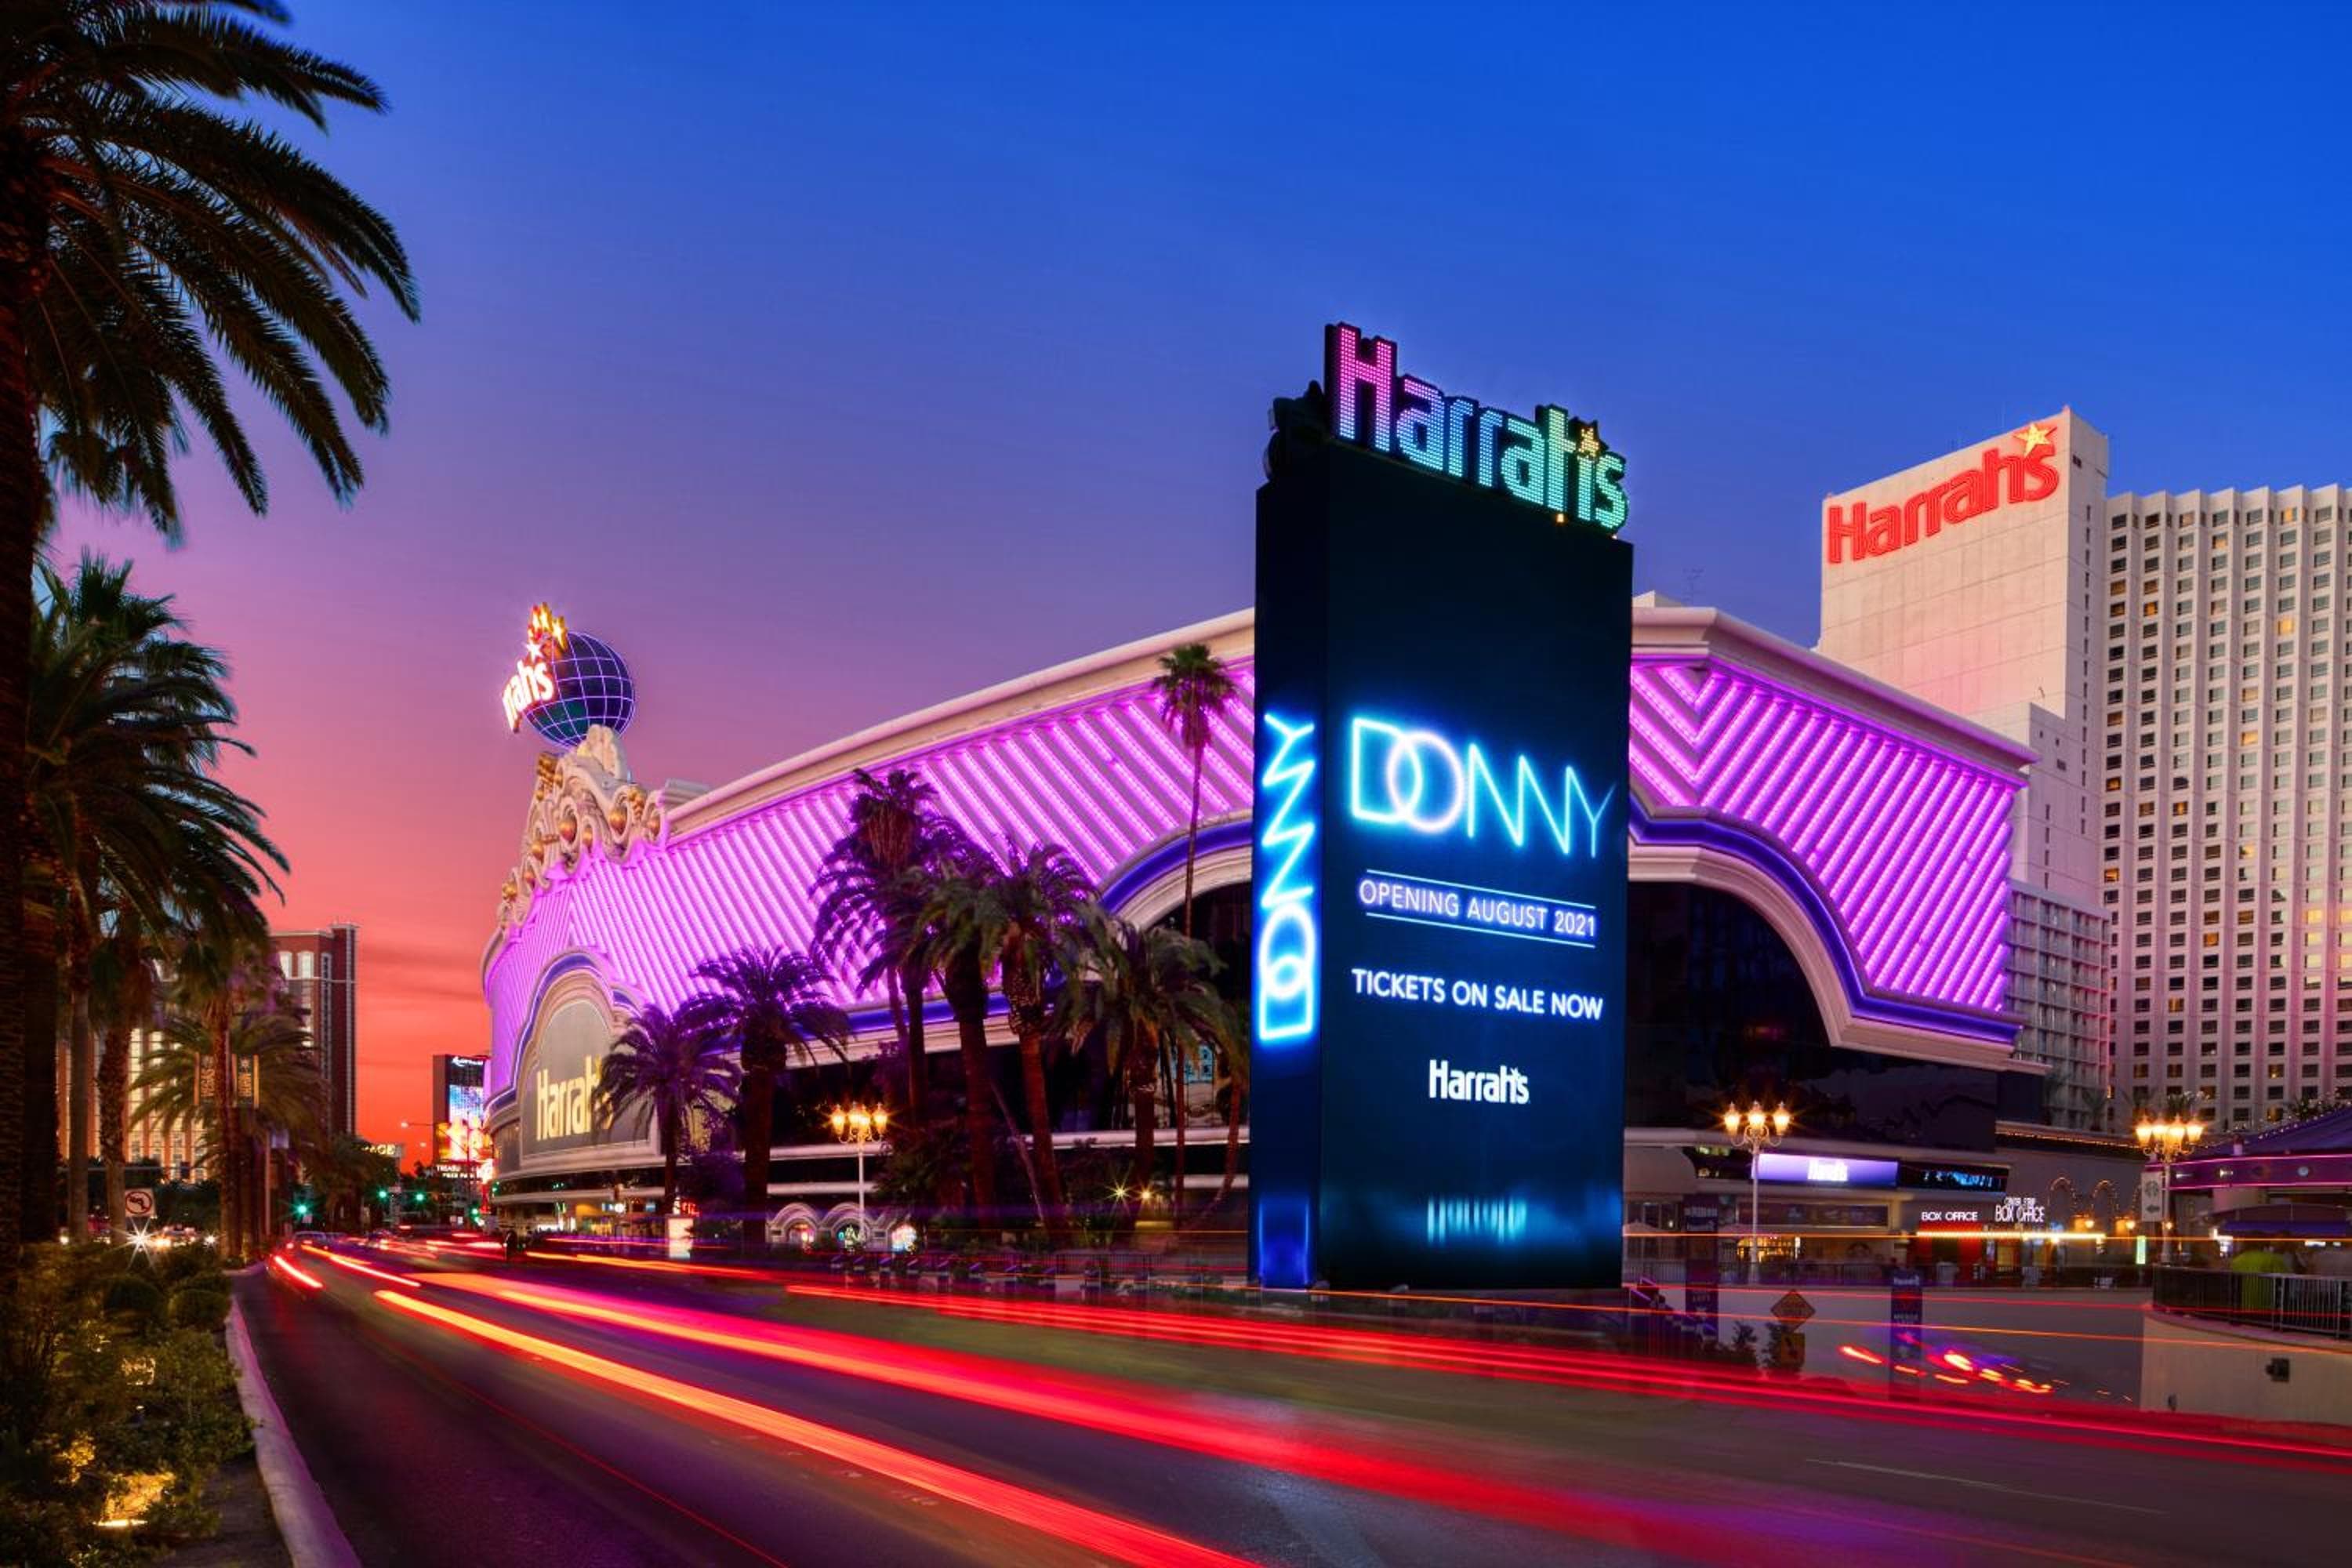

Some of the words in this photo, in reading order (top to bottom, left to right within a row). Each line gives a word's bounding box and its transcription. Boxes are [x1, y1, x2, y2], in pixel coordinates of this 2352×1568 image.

[1338, 326, 1627, 529] Harrah's
[1828, 423, 2060, 564] Harrah's
[1352, 716, 1617, 858] DONNY
[1359, 879, 1459, 917] OPENING
[1467, 898, 1548, 930] AUGUST
[1554, 910, 1595, 937] 2021
[1352, 968, 1446, 1004] TICKETS
[1452, 980, 1487, 1007] ON
[1494, 985, 1544, 1014] SALE
[1552, 993, 1603, 1020] NOW
[1429, 1059, 1530, 1104] Harrah's
[1922, 1211, 1942, 1221] BOX
[1945, 1211, 1978, 1221] OFFICE
[1995, 1204, 2014, 1222] BOX
[2016, 1206, 2045, 1223] OFFICE
